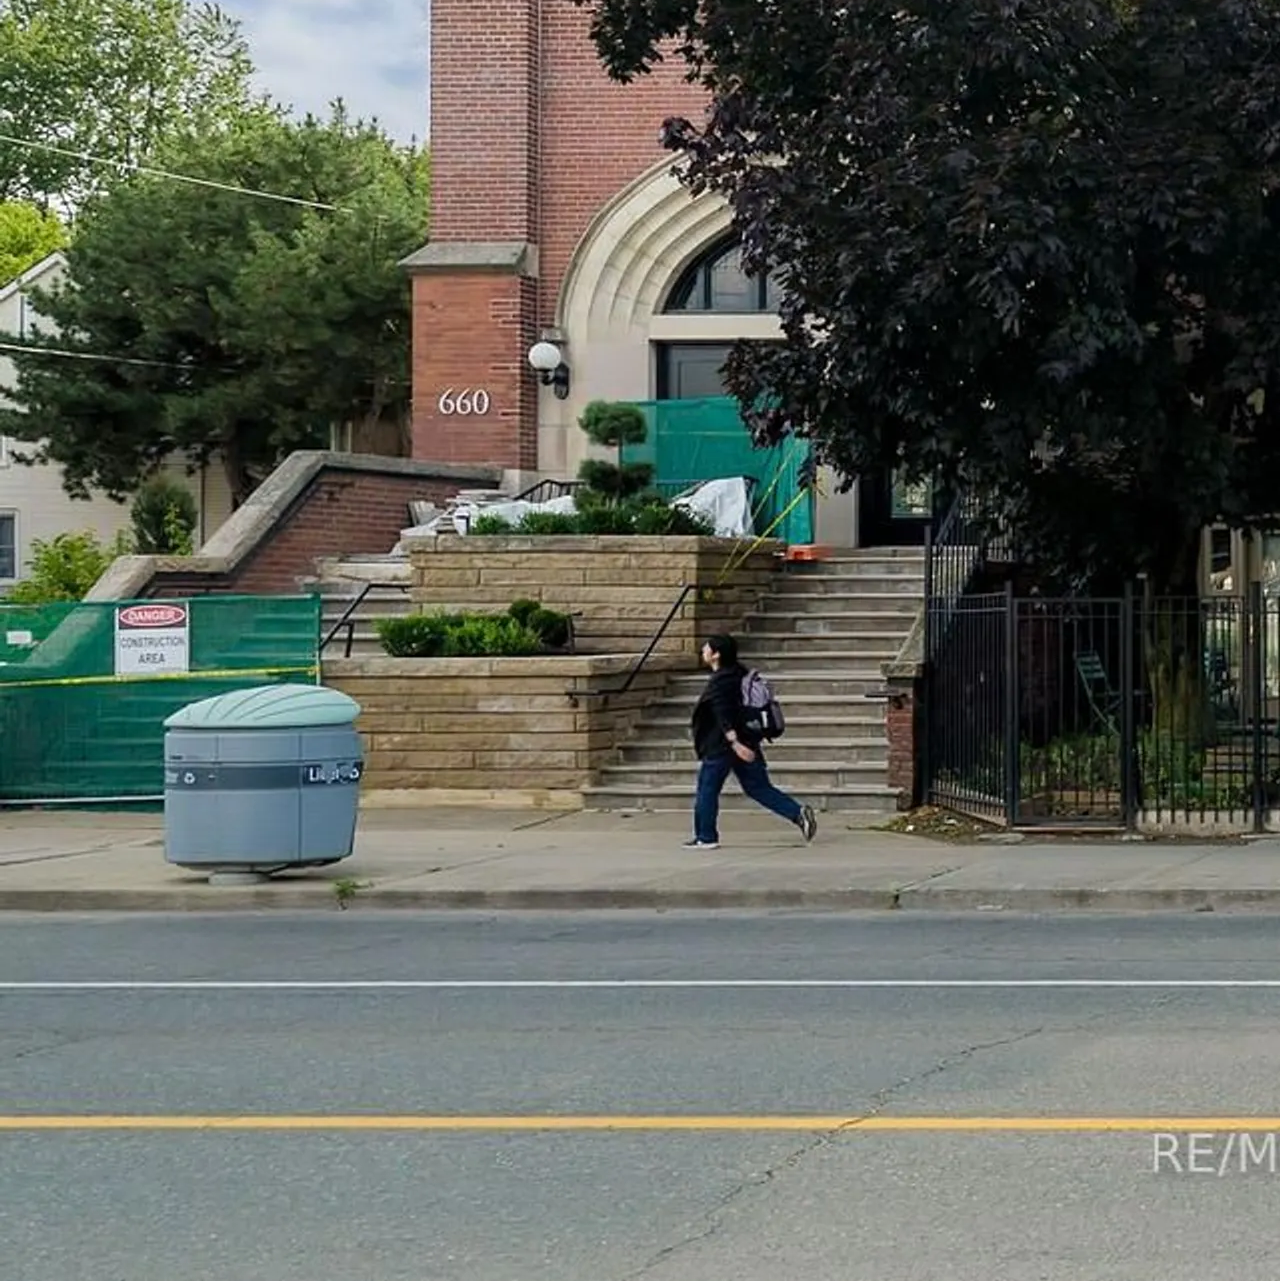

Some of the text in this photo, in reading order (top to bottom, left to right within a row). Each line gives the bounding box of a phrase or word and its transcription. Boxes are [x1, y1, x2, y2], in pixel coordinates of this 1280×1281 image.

[439, 388, 489, 414] 660
[128, 610, 175, 621] DANGER
[119, 636, 186, 648] CONSTRUCTION
[138, 653, 165, 663] AREA
